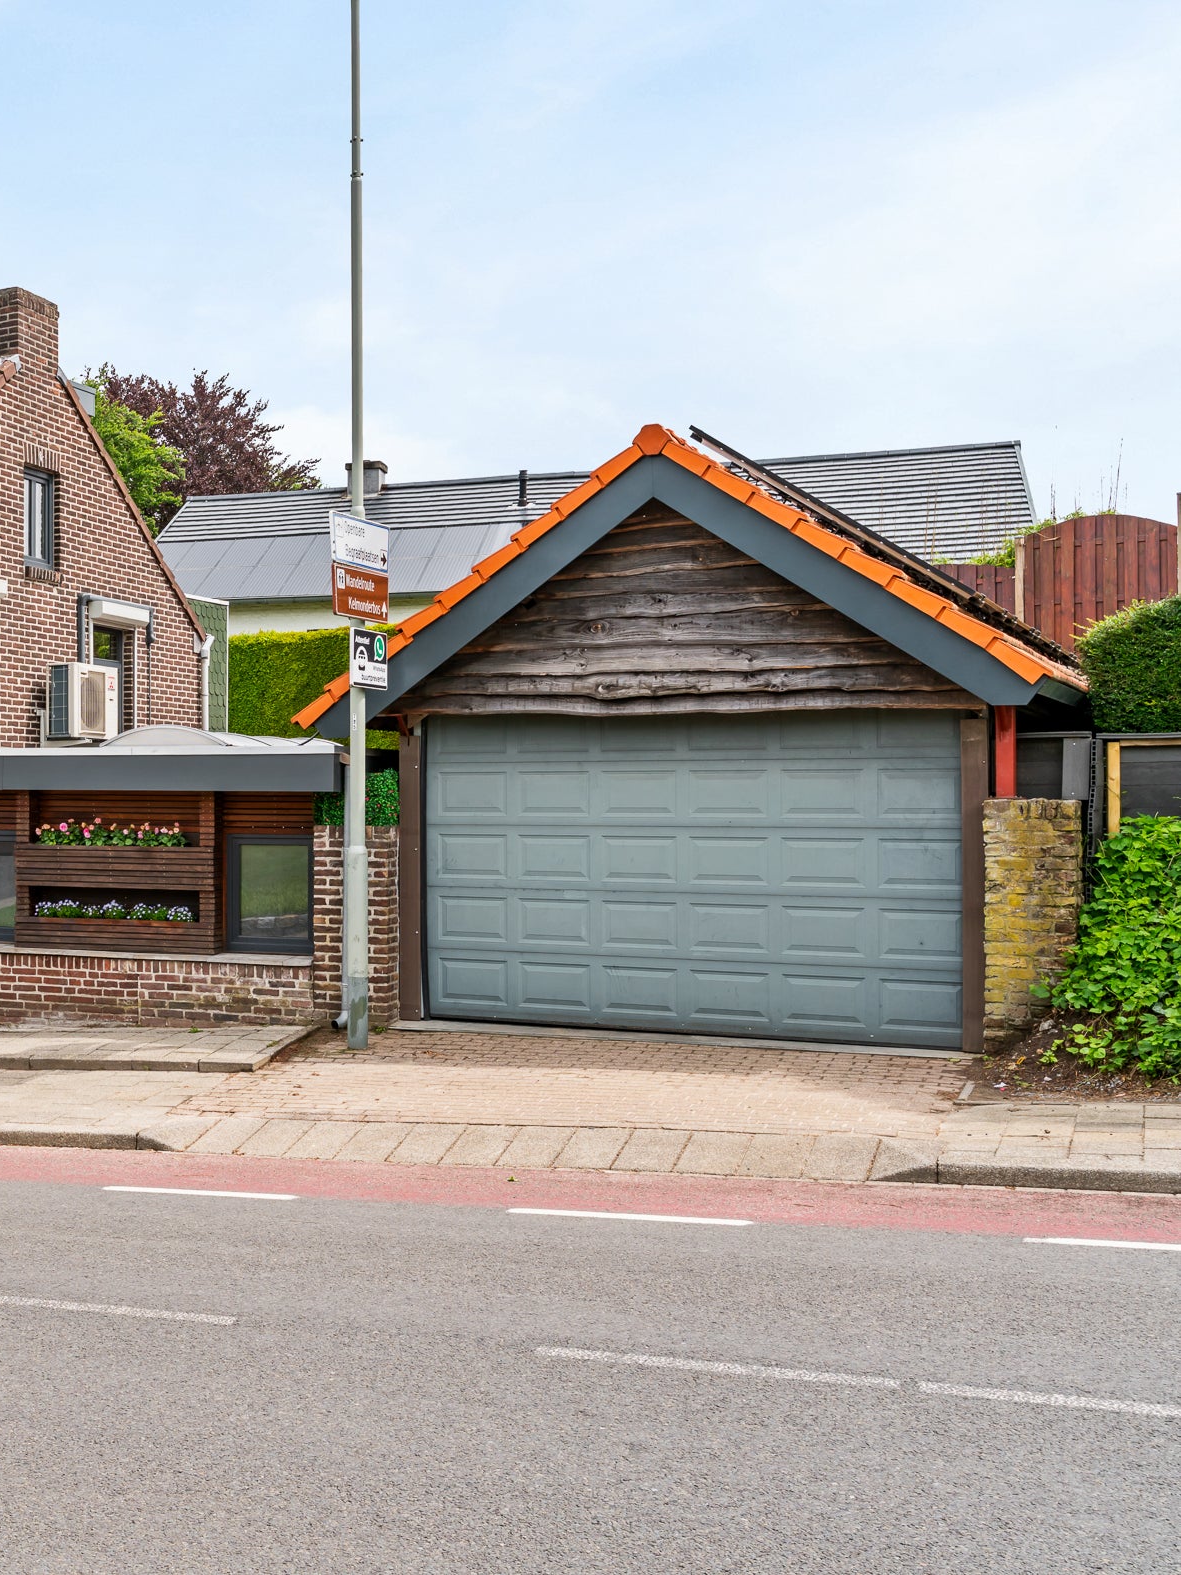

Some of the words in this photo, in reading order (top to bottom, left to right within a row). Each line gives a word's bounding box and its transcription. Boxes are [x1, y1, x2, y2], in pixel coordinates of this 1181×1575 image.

[345, 543, 379, 564] Begraafplaatsen
[346, 573, 375, 592] Wandelroute
[348, 596, 381, 615] Kelmonderbos
